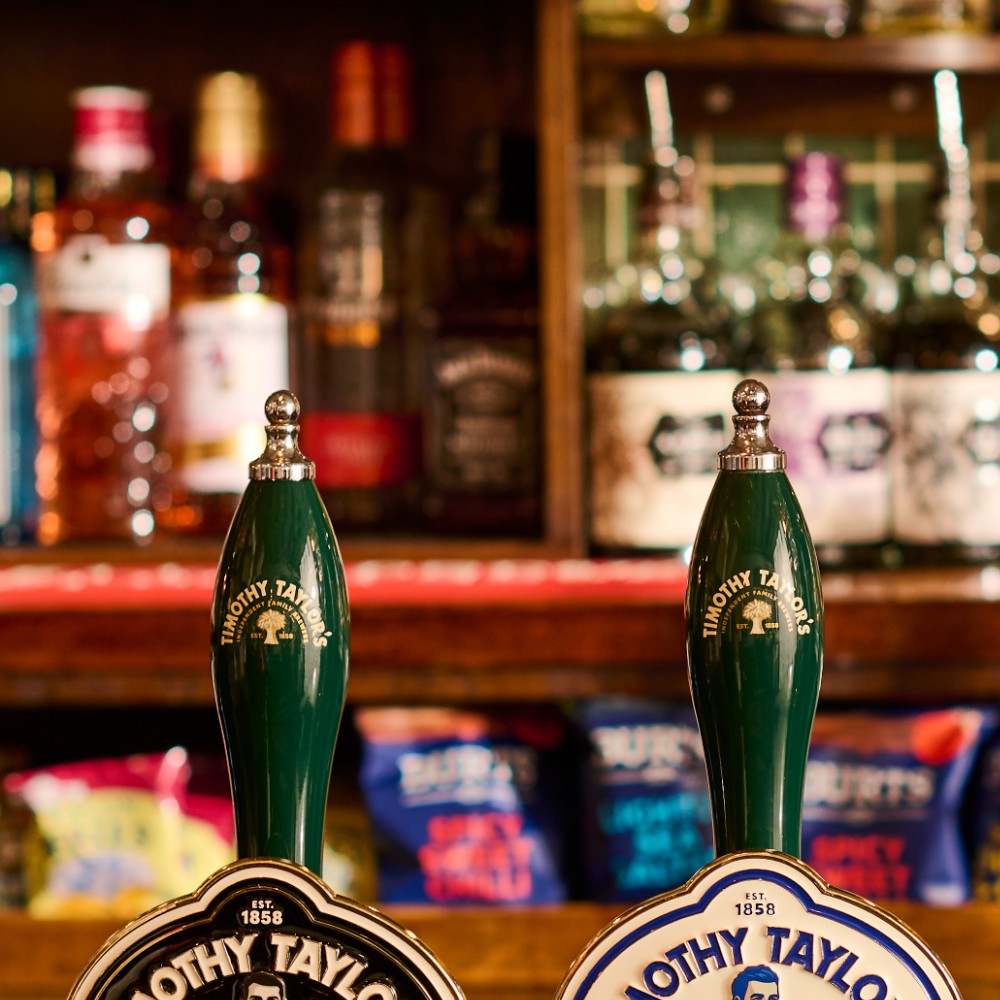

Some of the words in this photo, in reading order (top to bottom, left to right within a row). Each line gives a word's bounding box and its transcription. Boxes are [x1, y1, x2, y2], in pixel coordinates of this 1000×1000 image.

[703, 570, 751, 638] TIMOTHY
[759, 569, 814, 636] TAYLOR'S
[221, 580, 268, 646] TIMOTHY
[276, 580, 333, 647] TAYLOR'S
[588, 724, 706, 771] BURT
[745, 892, 767, 901] EST.
[251, 900, 274, 910] EST.
[735, 903, 776, 916] 1858
[241, 910, 283, 926] 1858
